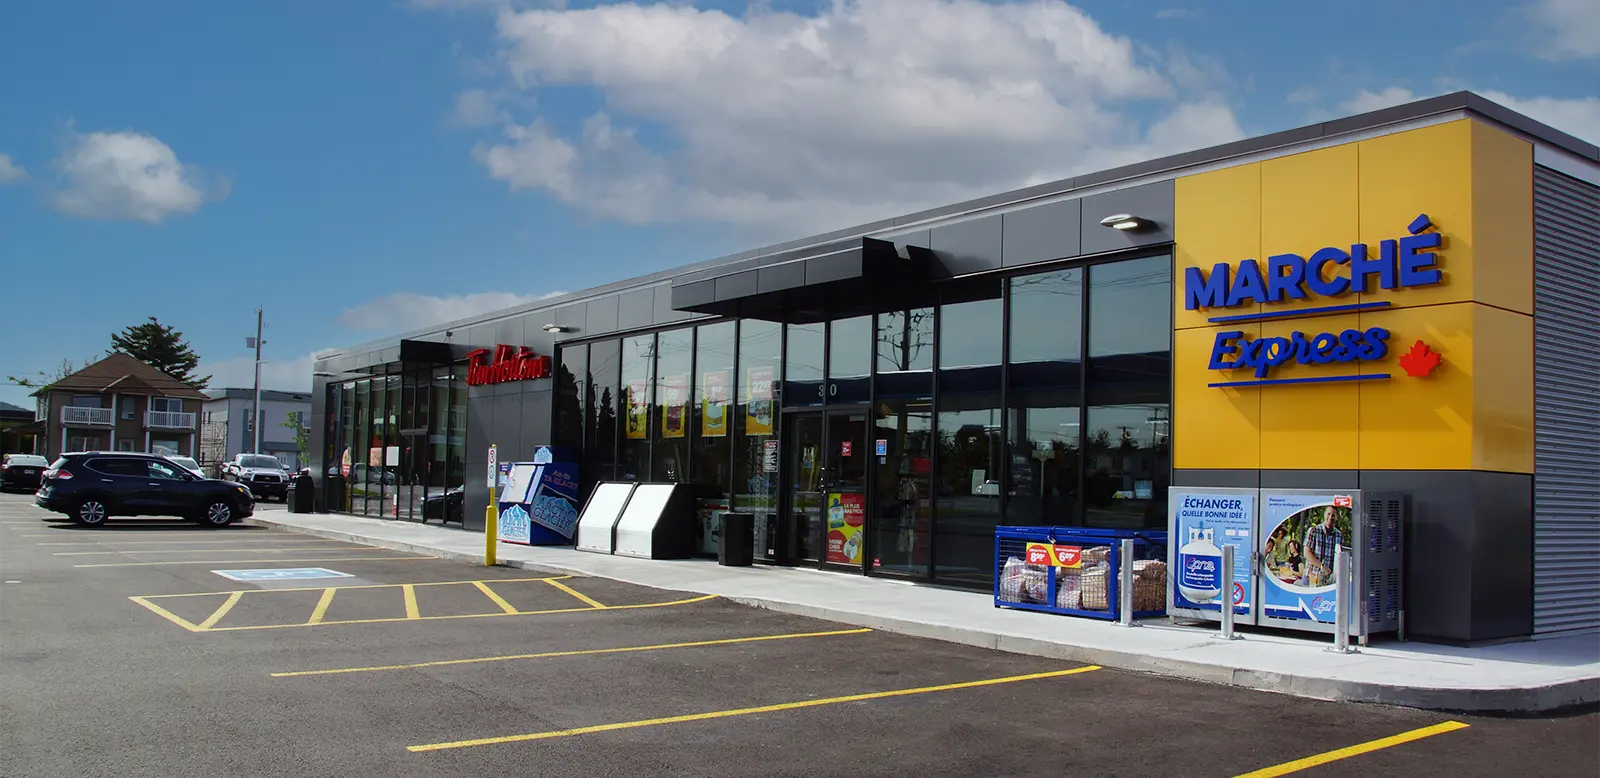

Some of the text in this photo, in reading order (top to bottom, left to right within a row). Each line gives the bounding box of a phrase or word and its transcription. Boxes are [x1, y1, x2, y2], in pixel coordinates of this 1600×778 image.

[1185, 213, 1442, 310] MARCHÉ
[1208, 327, 1391, 378] Express
[537, 496, 576, 523] ARCTIC
[1184, 495, 1243, 511] ÉCHANGER,
[1229, 510, 1242, 519] IDÉE
[534, 508, 572, 531] GLACIER
